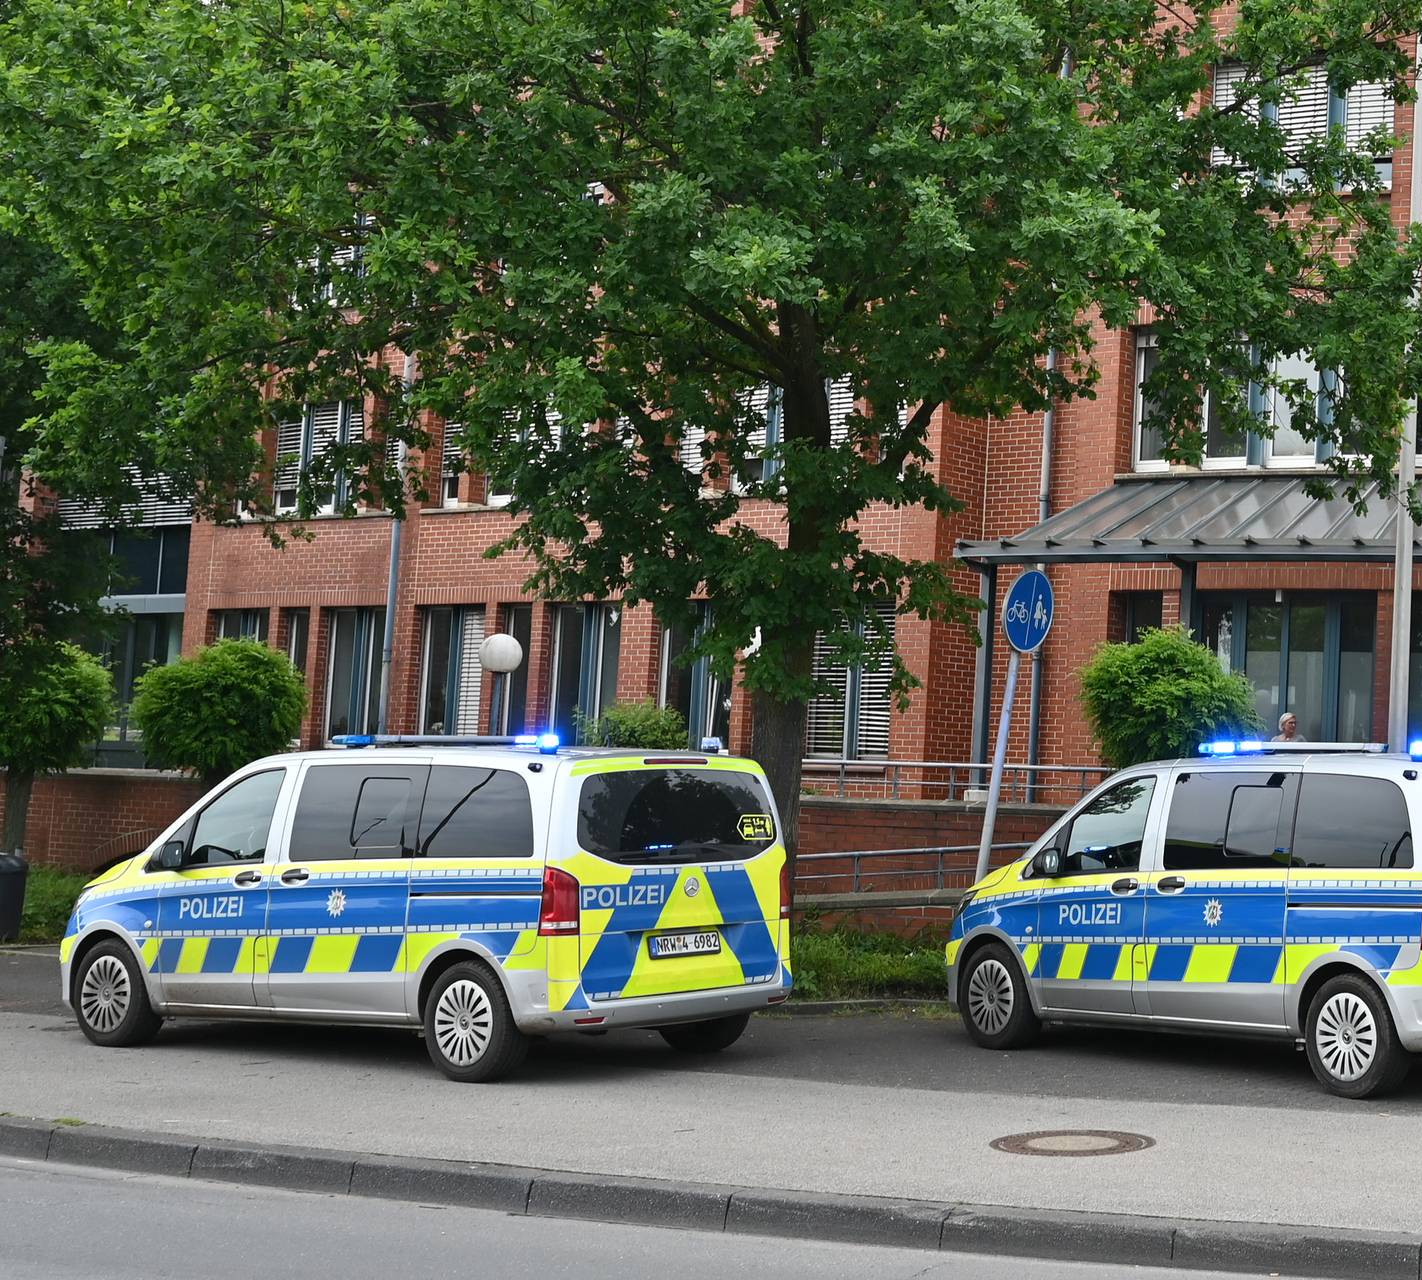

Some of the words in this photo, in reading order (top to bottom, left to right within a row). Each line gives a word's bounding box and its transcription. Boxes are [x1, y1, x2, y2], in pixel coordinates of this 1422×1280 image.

[179, 896, 243, 919] POLIZEI
[583, 885, 665, 908] POLIZEI
[1059, 903, 1121, 925] POLIZEI
[656, 938, 677, 952] NRW
